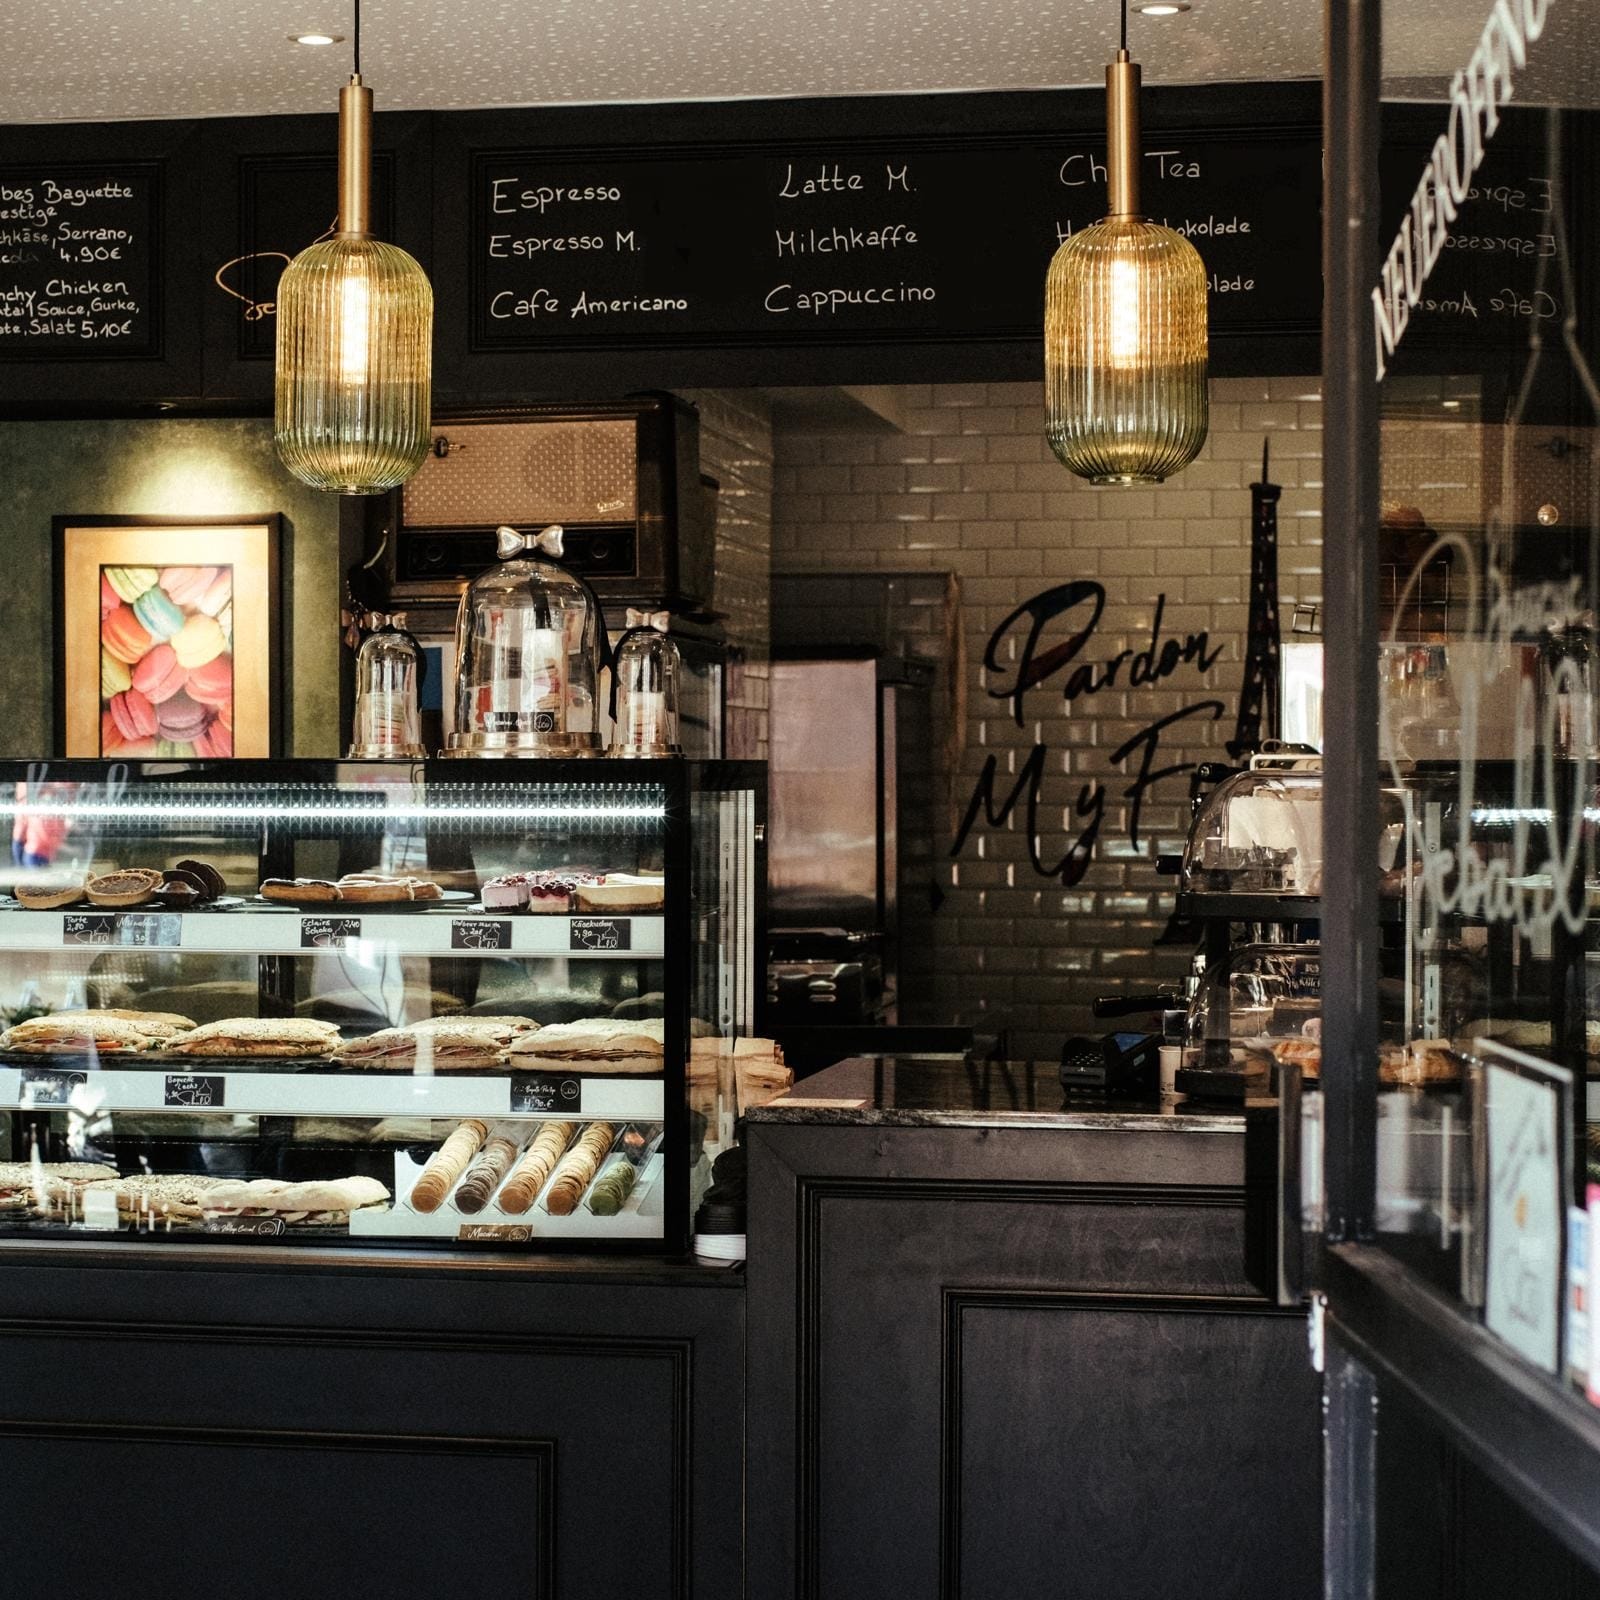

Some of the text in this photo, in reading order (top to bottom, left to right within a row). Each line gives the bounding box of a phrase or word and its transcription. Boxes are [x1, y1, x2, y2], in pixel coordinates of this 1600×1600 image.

[779, 164, 918, 198] Latte M.
[1059, 150, 1201, 186] Ch Tea
[41, 180, 134, 206] Baguette
[492, 178, 621, 214] Espresso
[57, 221, 133, 244] Serrano,
[489, 230, 642, 259] Espresso M.
[775, 225, 918, 257] Milchkaffe
[46, 279, 129, 296] Chicken
[764, 282, 936, 315] Cappuccino
[37, 301, 90, 318] Sauce,
[91, 296, 140, 314] Gurke,
[490, 289, 688, 319] Cafe Americano
[29, 318, 76, 335] Salat
[984, 580, 1224, 729] Pardon
[950, 743, 1106, 886] My
